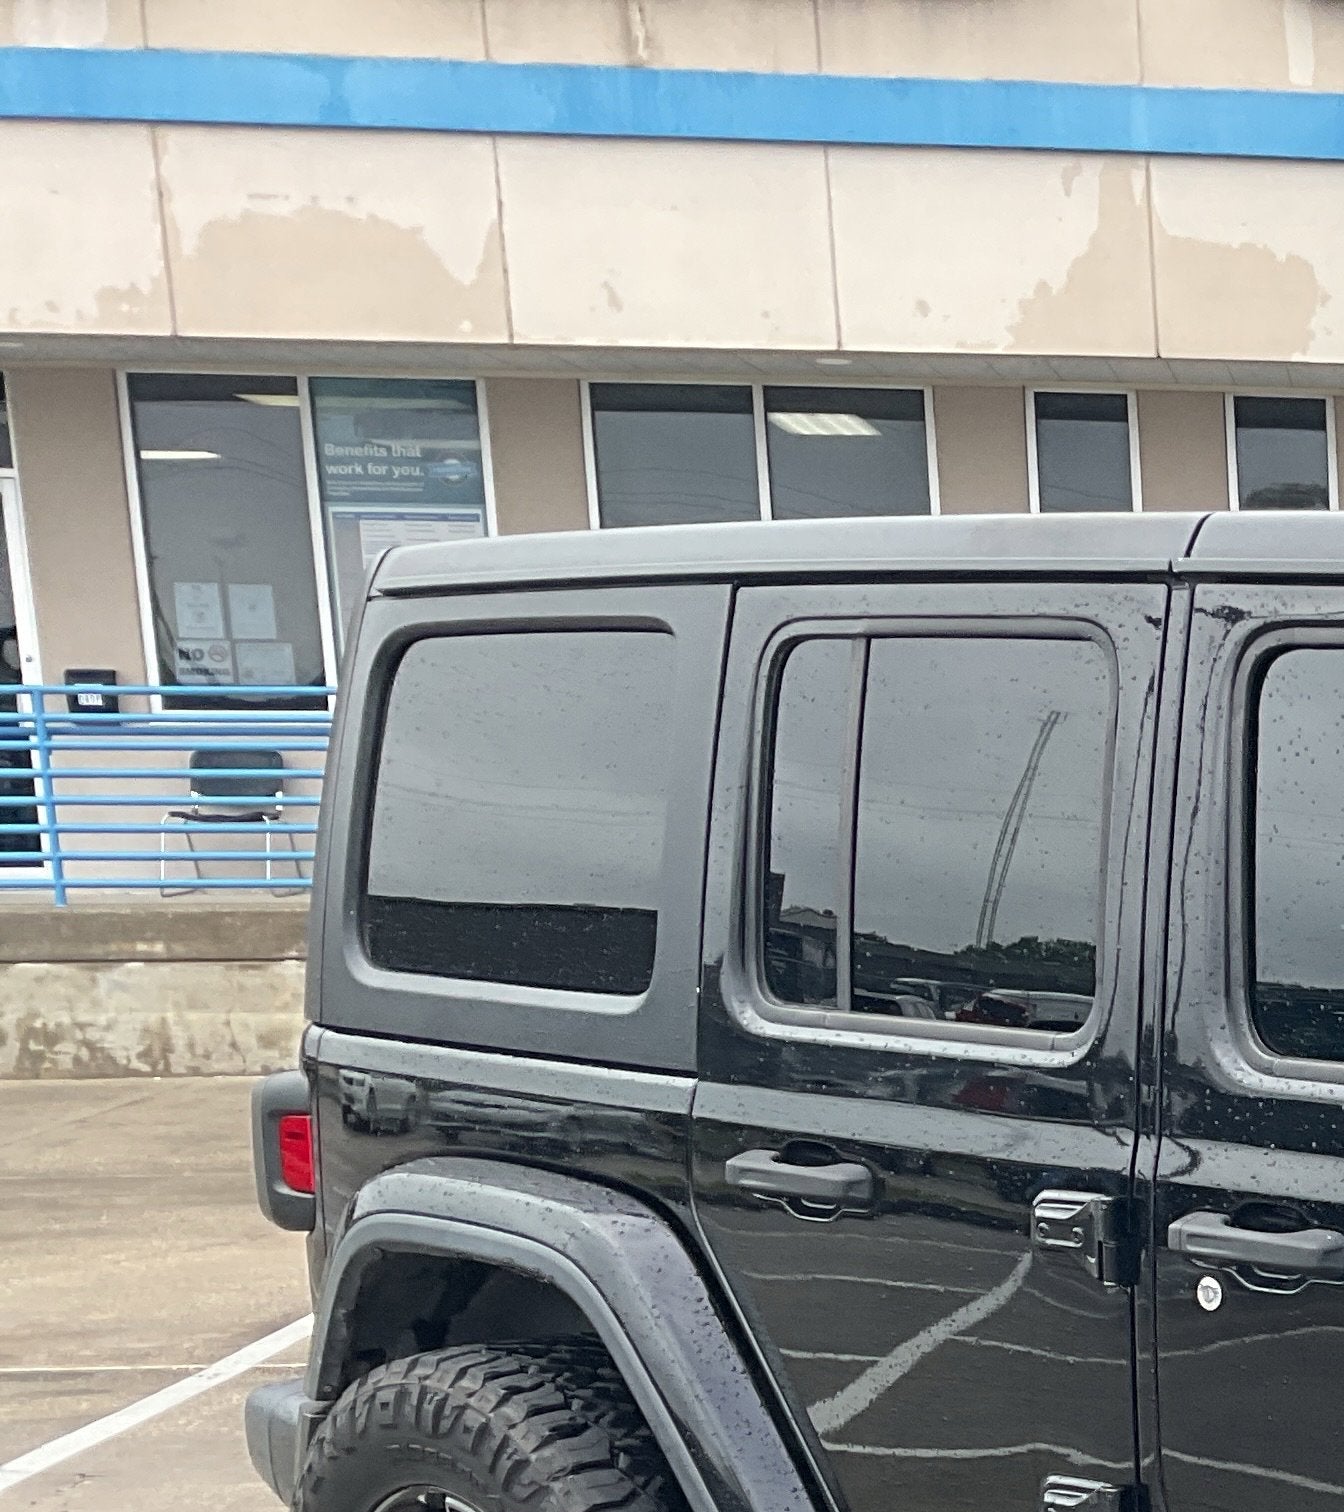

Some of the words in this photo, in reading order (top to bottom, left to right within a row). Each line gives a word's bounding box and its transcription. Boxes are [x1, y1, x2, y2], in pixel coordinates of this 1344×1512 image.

[324, 443, 388, 457] Benefits
[392, 443, 422, 458] that
[325, 463, 364, 475] work
[367, 463, 389, 476] for
[392, 466, 425, 479] you.
